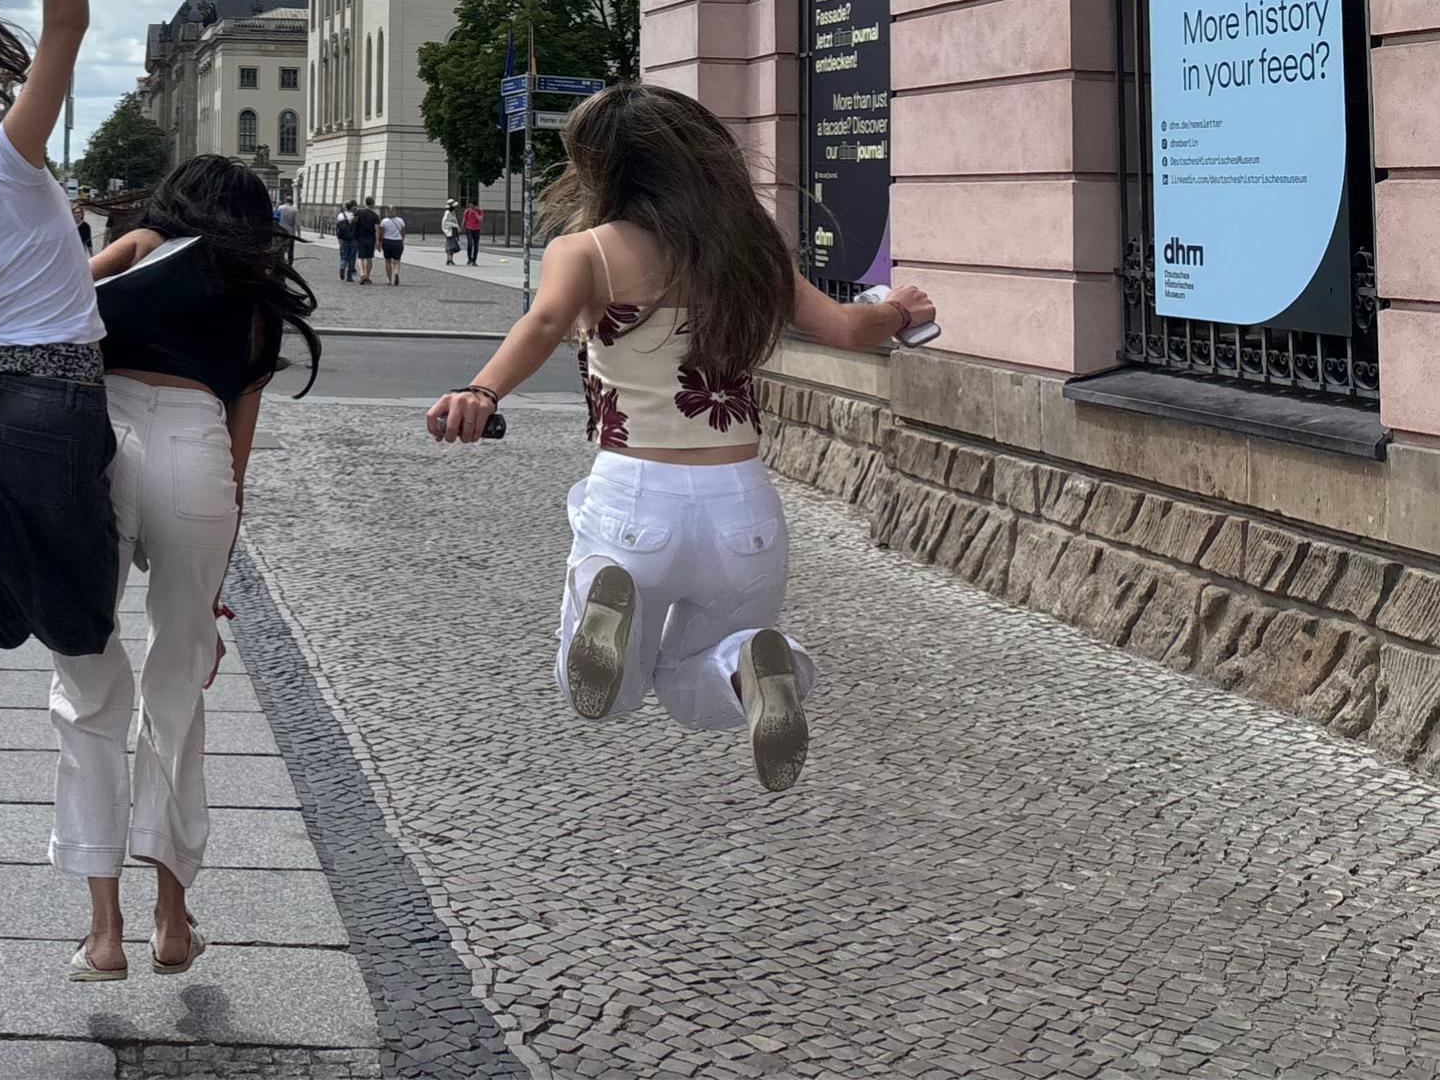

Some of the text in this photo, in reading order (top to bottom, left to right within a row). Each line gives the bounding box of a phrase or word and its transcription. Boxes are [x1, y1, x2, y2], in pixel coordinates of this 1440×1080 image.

[816, 2, 851, 26] Fassade?
[1184, 0, 1329, 45] More history
[815, 31, 833, 50] Jetzt
[815, 50, 857, 73] entdecken!
[1183, 41, 1330, 97] in your feed?
[833, 90, 888, 111] More than just
[817, 116, 888, 136] a facade? Discover
[825, 145, 839, 159] our
[1170, 155, 1260, 166] DeutschesHistorischesMuseum
[815, 226, 833, 246] dhm
[1164, 236, 1204, 266] dhm
